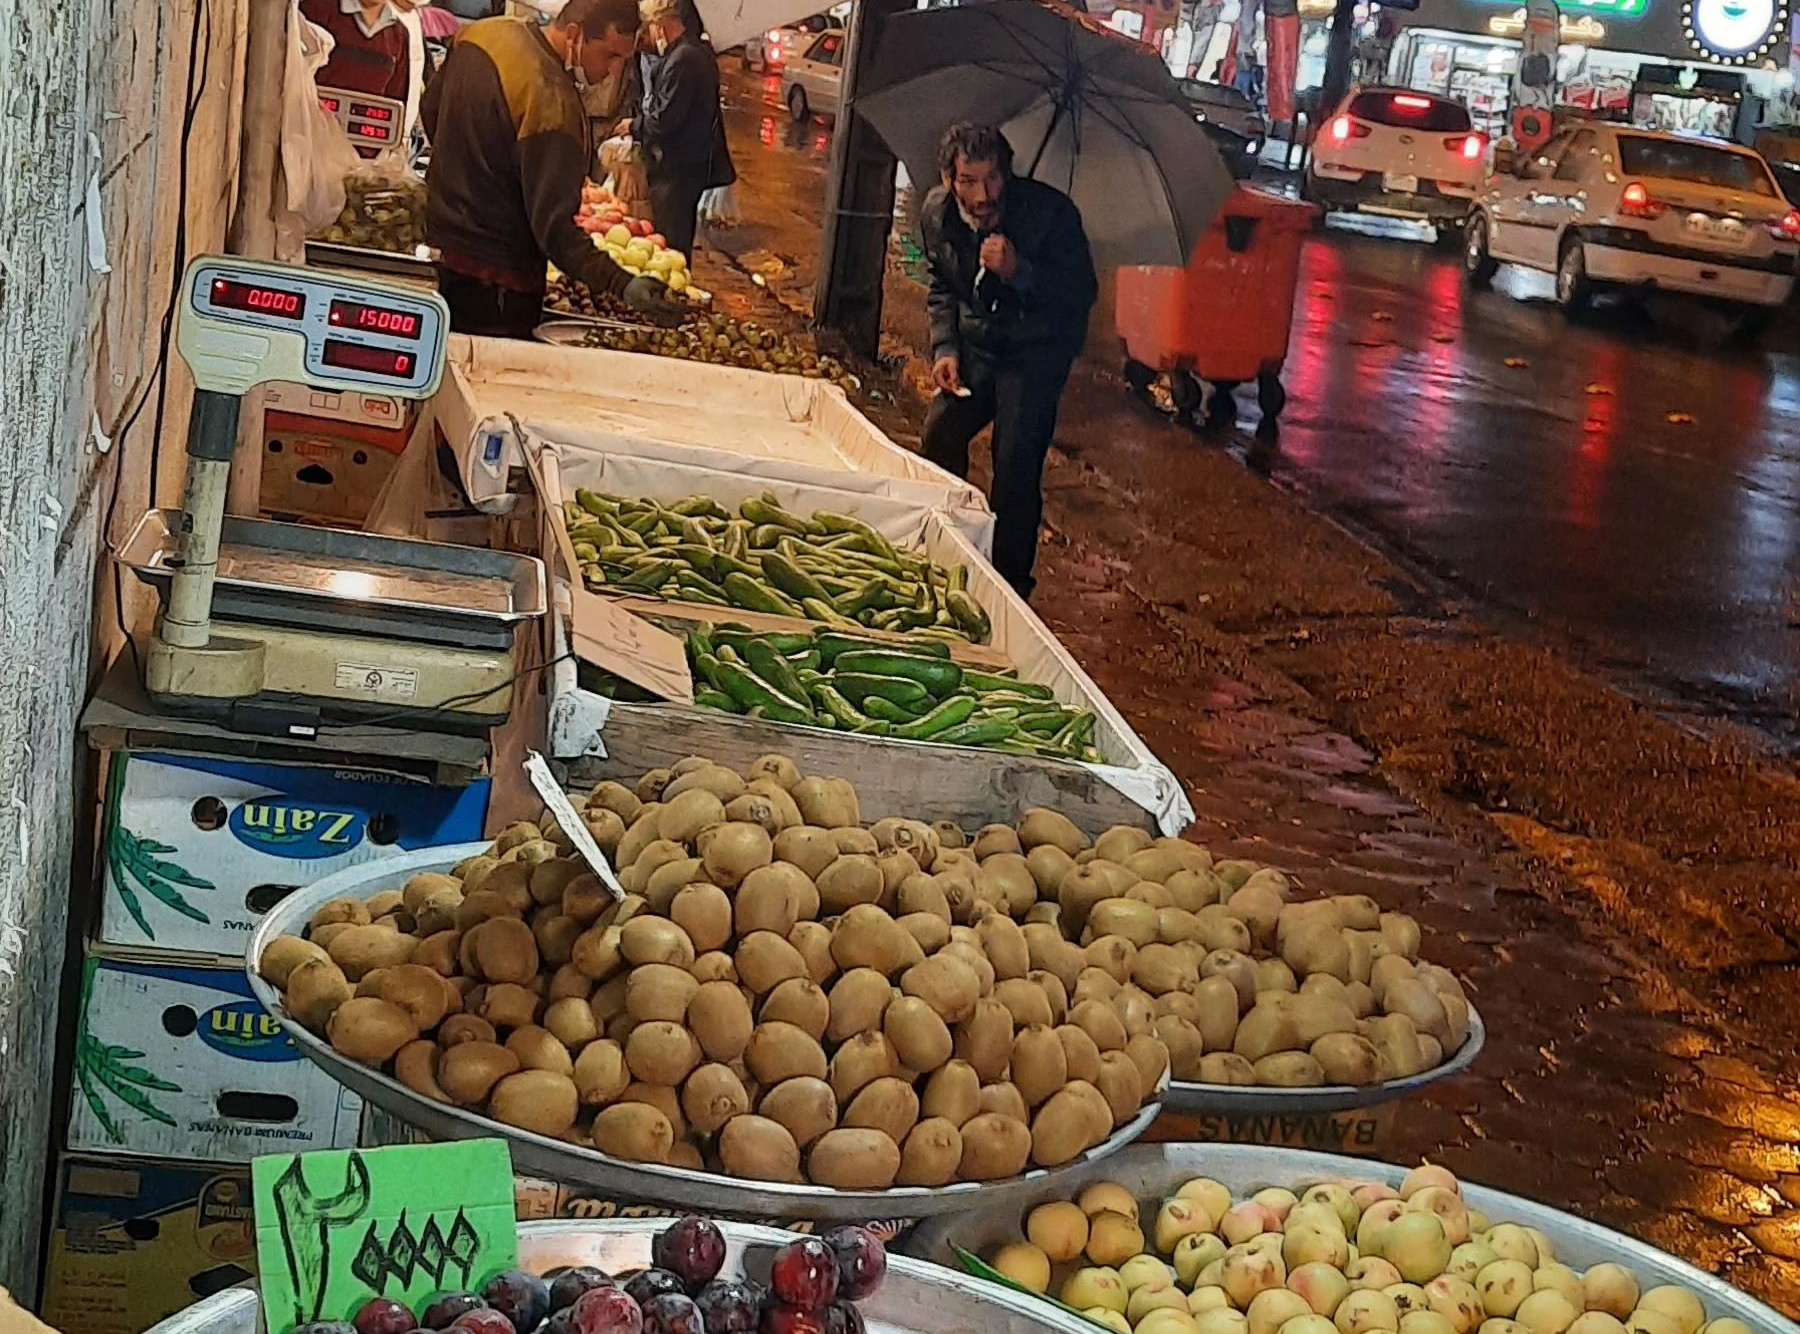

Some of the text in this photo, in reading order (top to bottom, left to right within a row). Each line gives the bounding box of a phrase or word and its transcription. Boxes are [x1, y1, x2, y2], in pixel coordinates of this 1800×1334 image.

[359, 308, 416, 332] 15000
[394, 354, 410, 372] 0
[242, 800, 356, 844] Zain
[211, 1009, 288, 1041] ain
[1197, 1116, 1378, 1147] BANANAS
